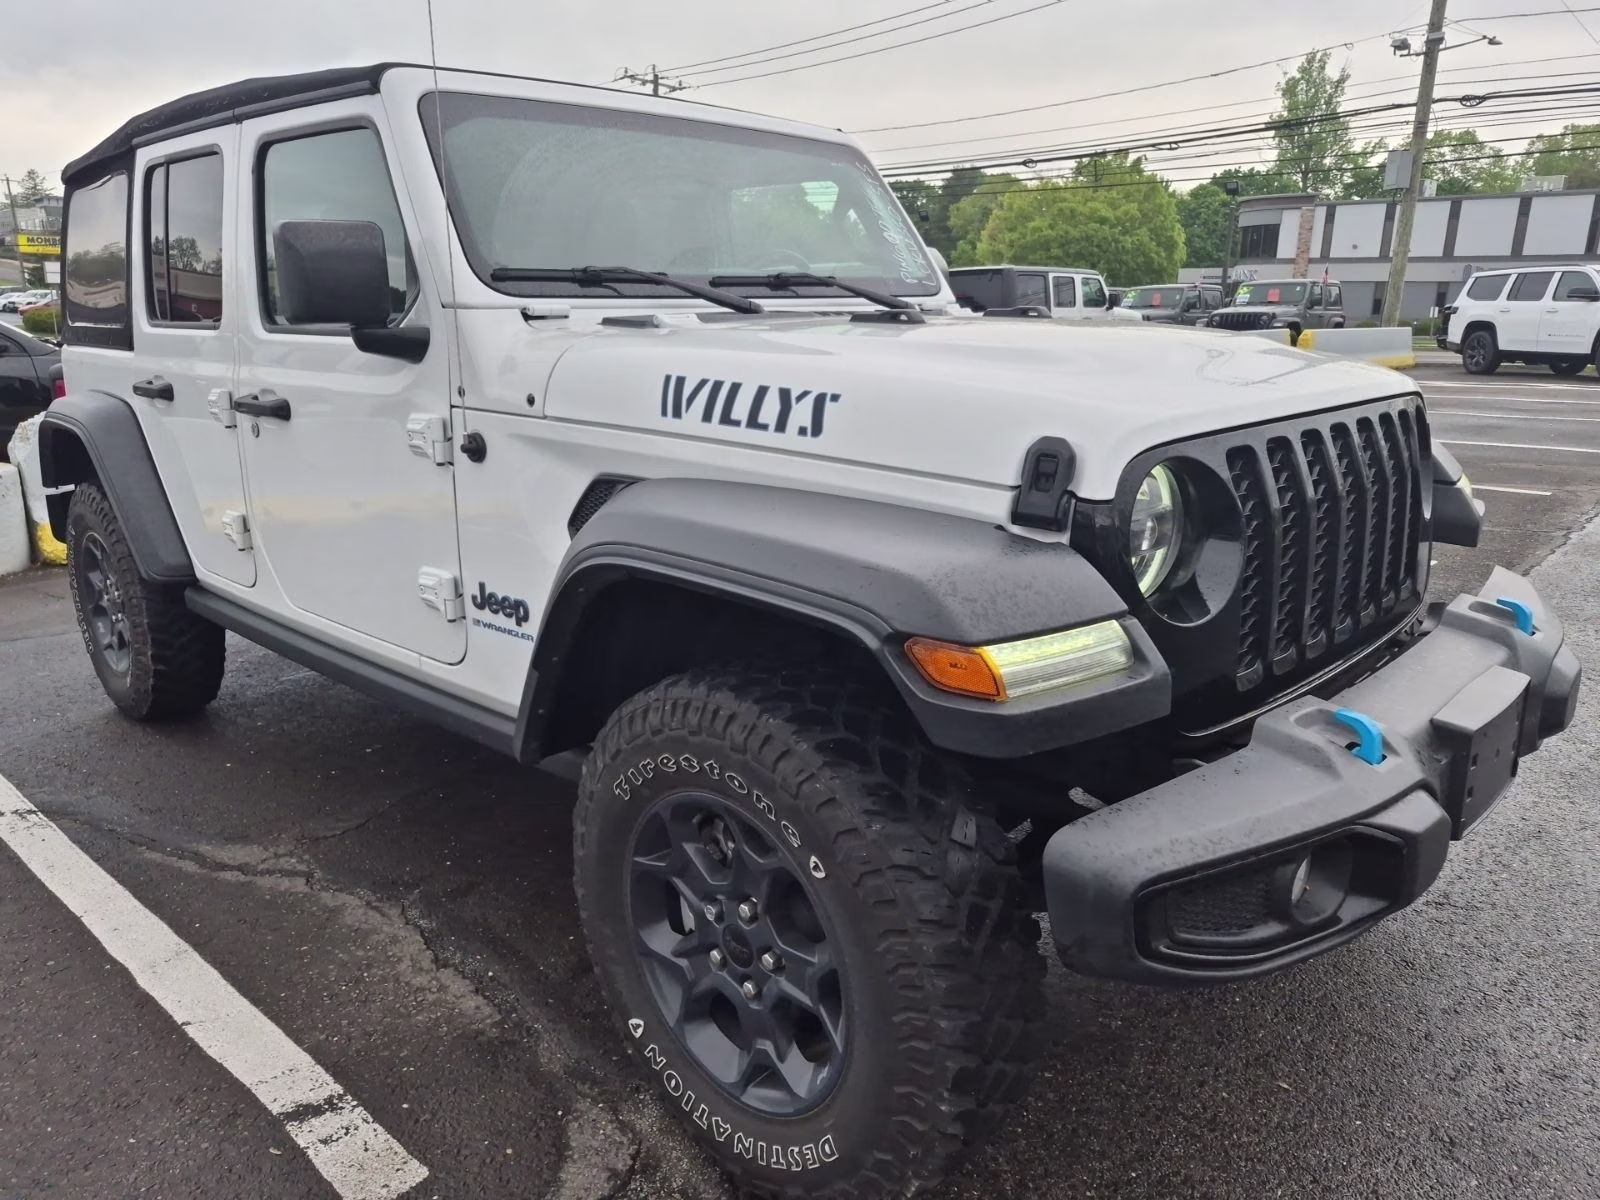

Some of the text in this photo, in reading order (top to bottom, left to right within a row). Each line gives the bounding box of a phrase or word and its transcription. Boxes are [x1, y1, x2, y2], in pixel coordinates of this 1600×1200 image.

[661, 374, 842, 438] WILLYS
[471, 581, 530, 628] Jeep
[481, 620, 535, 643] WRANGLER
[644, 1044, 840, 1172] DESTINATION
